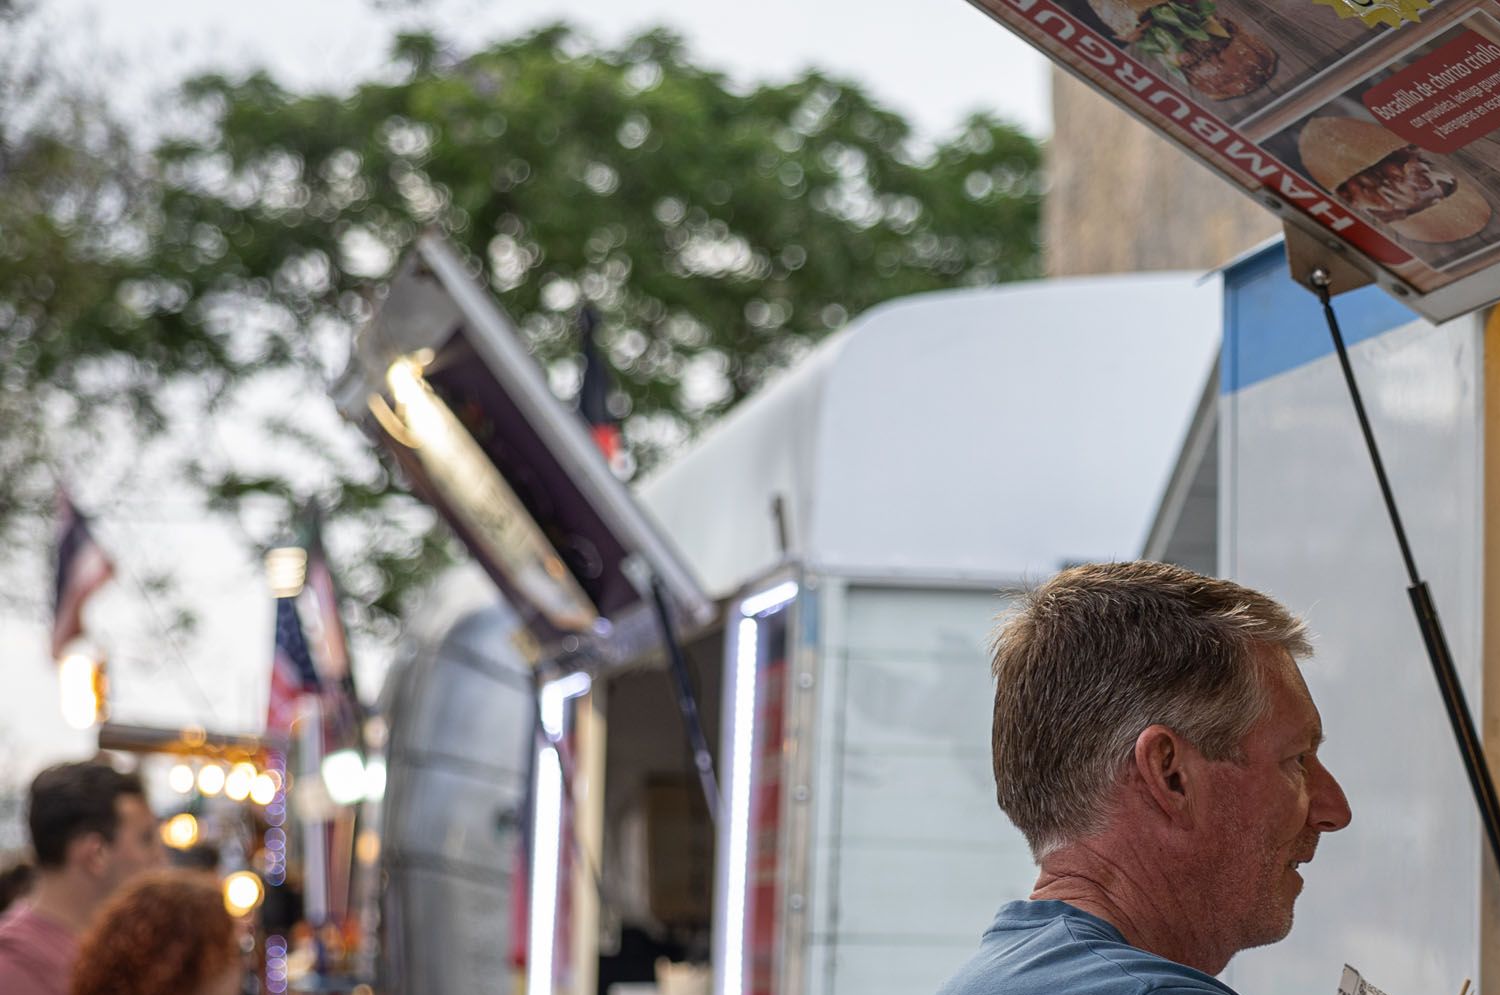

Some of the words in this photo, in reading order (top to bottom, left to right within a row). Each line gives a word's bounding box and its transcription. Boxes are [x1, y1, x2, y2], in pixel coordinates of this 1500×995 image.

[1371, 86, 1424, 121] Bocadillo
[1414, 81, 1438, 98] de
[1428, 64, 1472, 91] chorizo
[1410, 114, 1428, 129] con
[1450, 84, 1484, 107] lechuga
